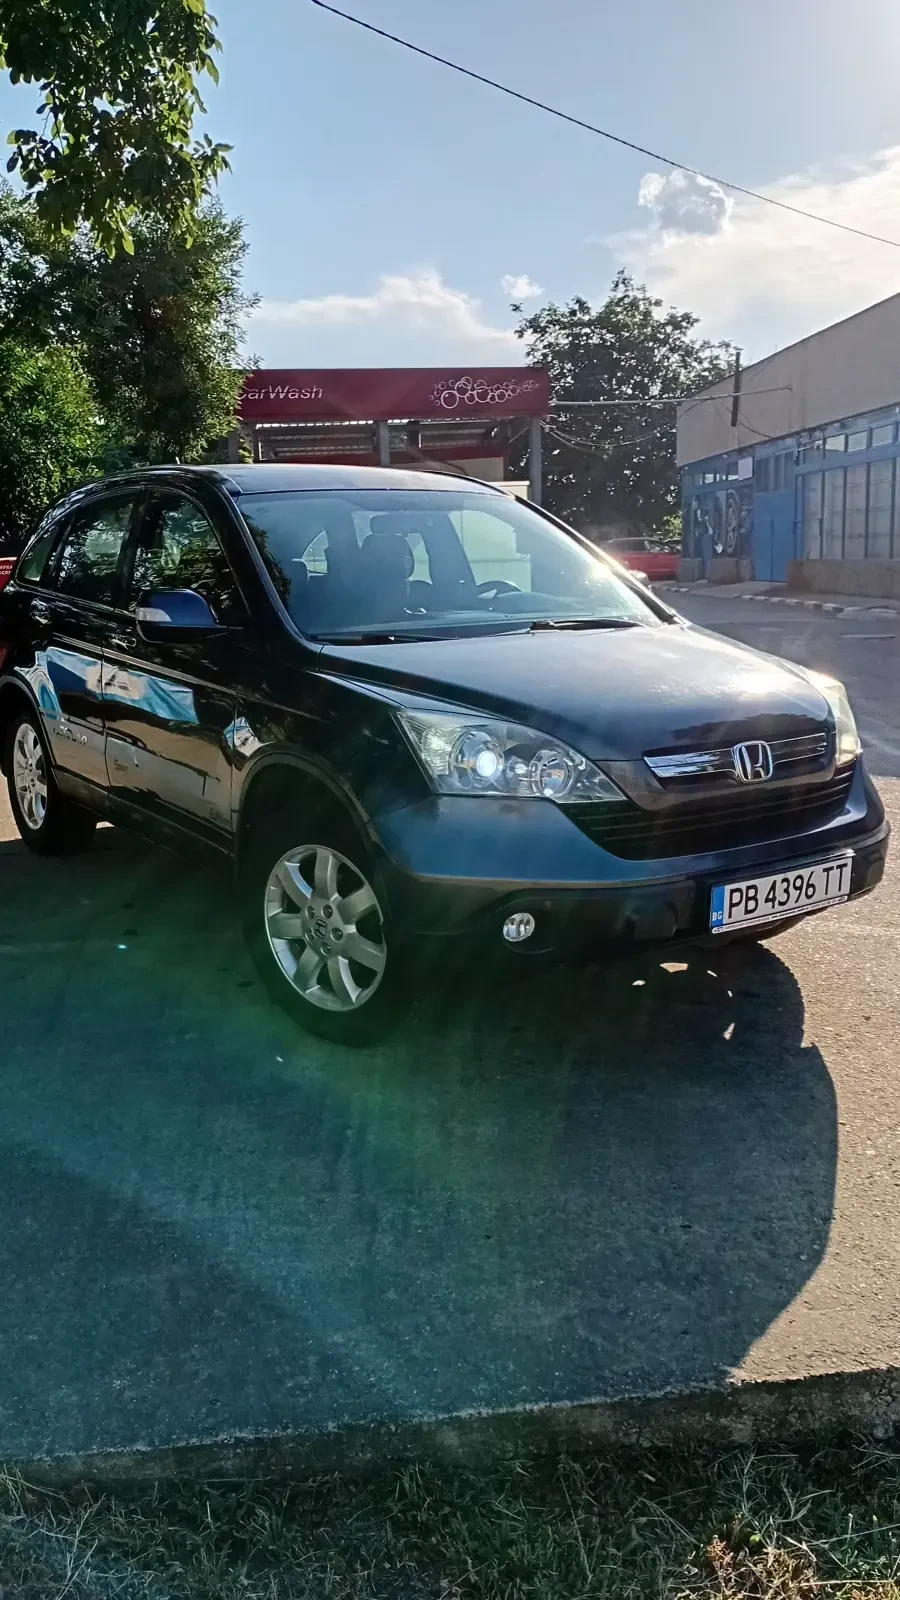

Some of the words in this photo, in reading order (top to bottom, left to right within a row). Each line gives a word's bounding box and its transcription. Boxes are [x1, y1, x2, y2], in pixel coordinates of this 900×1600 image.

[727, 883, 759, 919] PB
[764, 871, 817, 909] 4396
[822, 863, 848, 896] TT
[712, 911, 723, 921] BG
